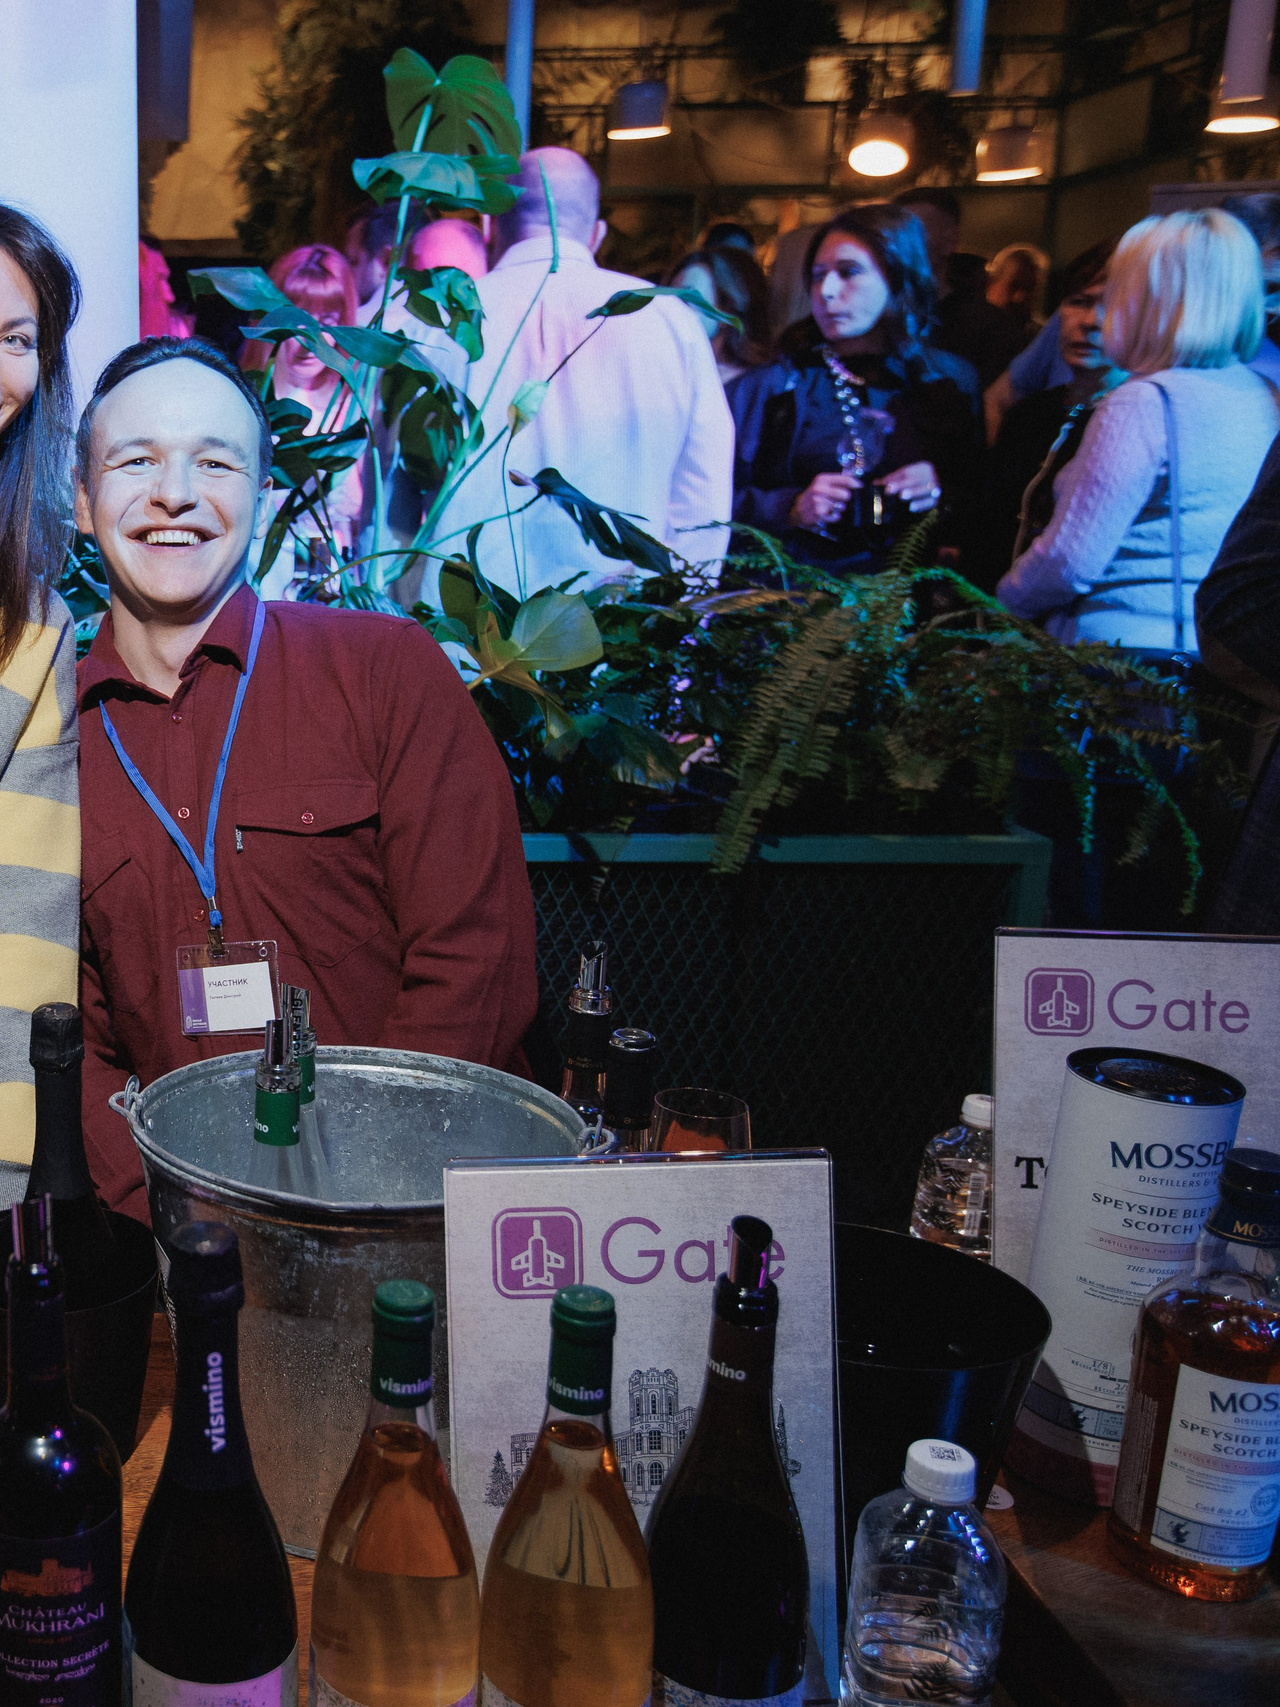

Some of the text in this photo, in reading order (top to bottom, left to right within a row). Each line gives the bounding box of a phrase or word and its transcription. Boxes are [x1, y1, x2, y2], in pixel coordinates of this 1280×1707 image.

[208, 978, 249, 988] УЧАСТНИК
[1107, 978, 1250, 1034] Gate
[1139, 1174, 1201, 1188] DISTILLERS
[1091, 1192, 1213, 1219] SPEYSIDE BLEN
[1122, 1217, 1193, 1234] SCOTCH
[601, 1216, 785, 1284] Gae
[1099, 1236, 1139, 1252] DISTILLED
[1126, 1264, 1145, 1273] THE
[708, 1358, 747, 1381] mino
[202, 1351, 227, 1454] vismino
[1209, 1391, 1280, 1413] MOS
[1179, 1419, 1261, 1444] SPEYSIDE
[1212, 1443, 1277, 1458] SCOTCH
[8, 1601, 87, 1617] CHÂTEAU
[62, 1639, 110, 1667] SECRÈTE
[40, 1696, 64, 1704] 2020
